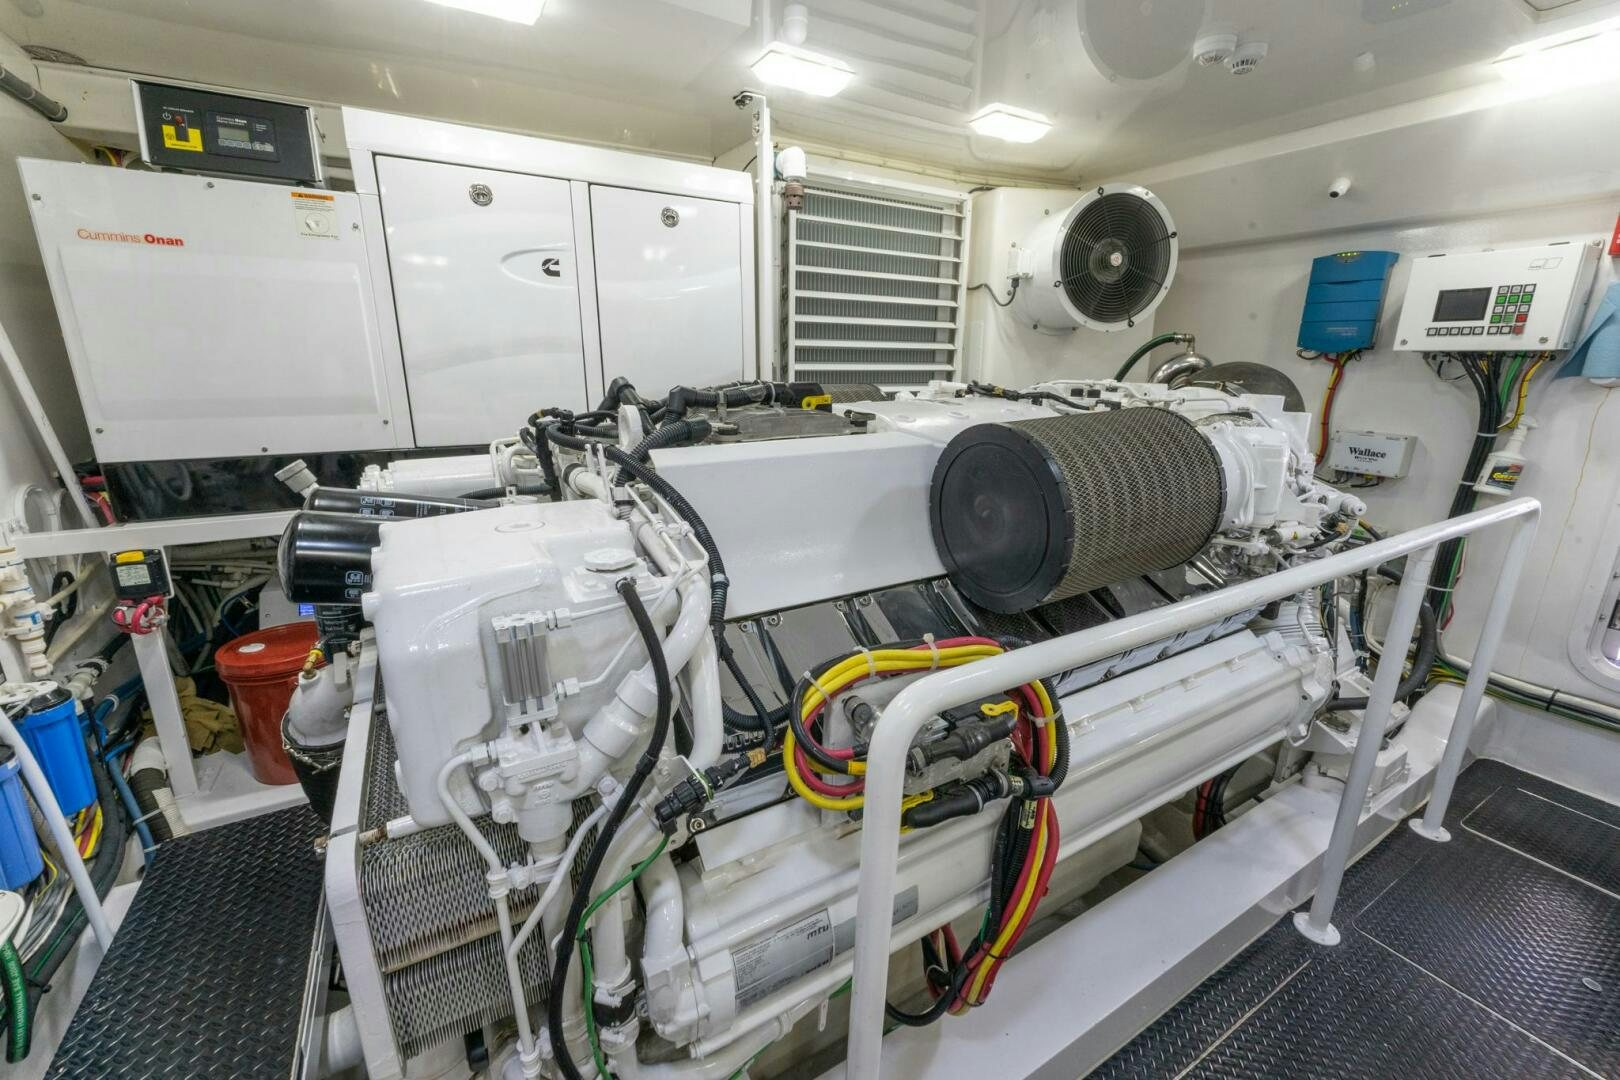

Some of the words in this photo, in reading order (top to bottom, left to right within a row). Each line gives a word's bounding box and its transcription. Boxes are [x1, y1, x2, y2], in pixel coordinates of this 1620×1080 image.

[77, 228, 141, 243] Cummins
[144, 233, 184, 247] Onan
[1348, 447, 1387, 458] Wallace
